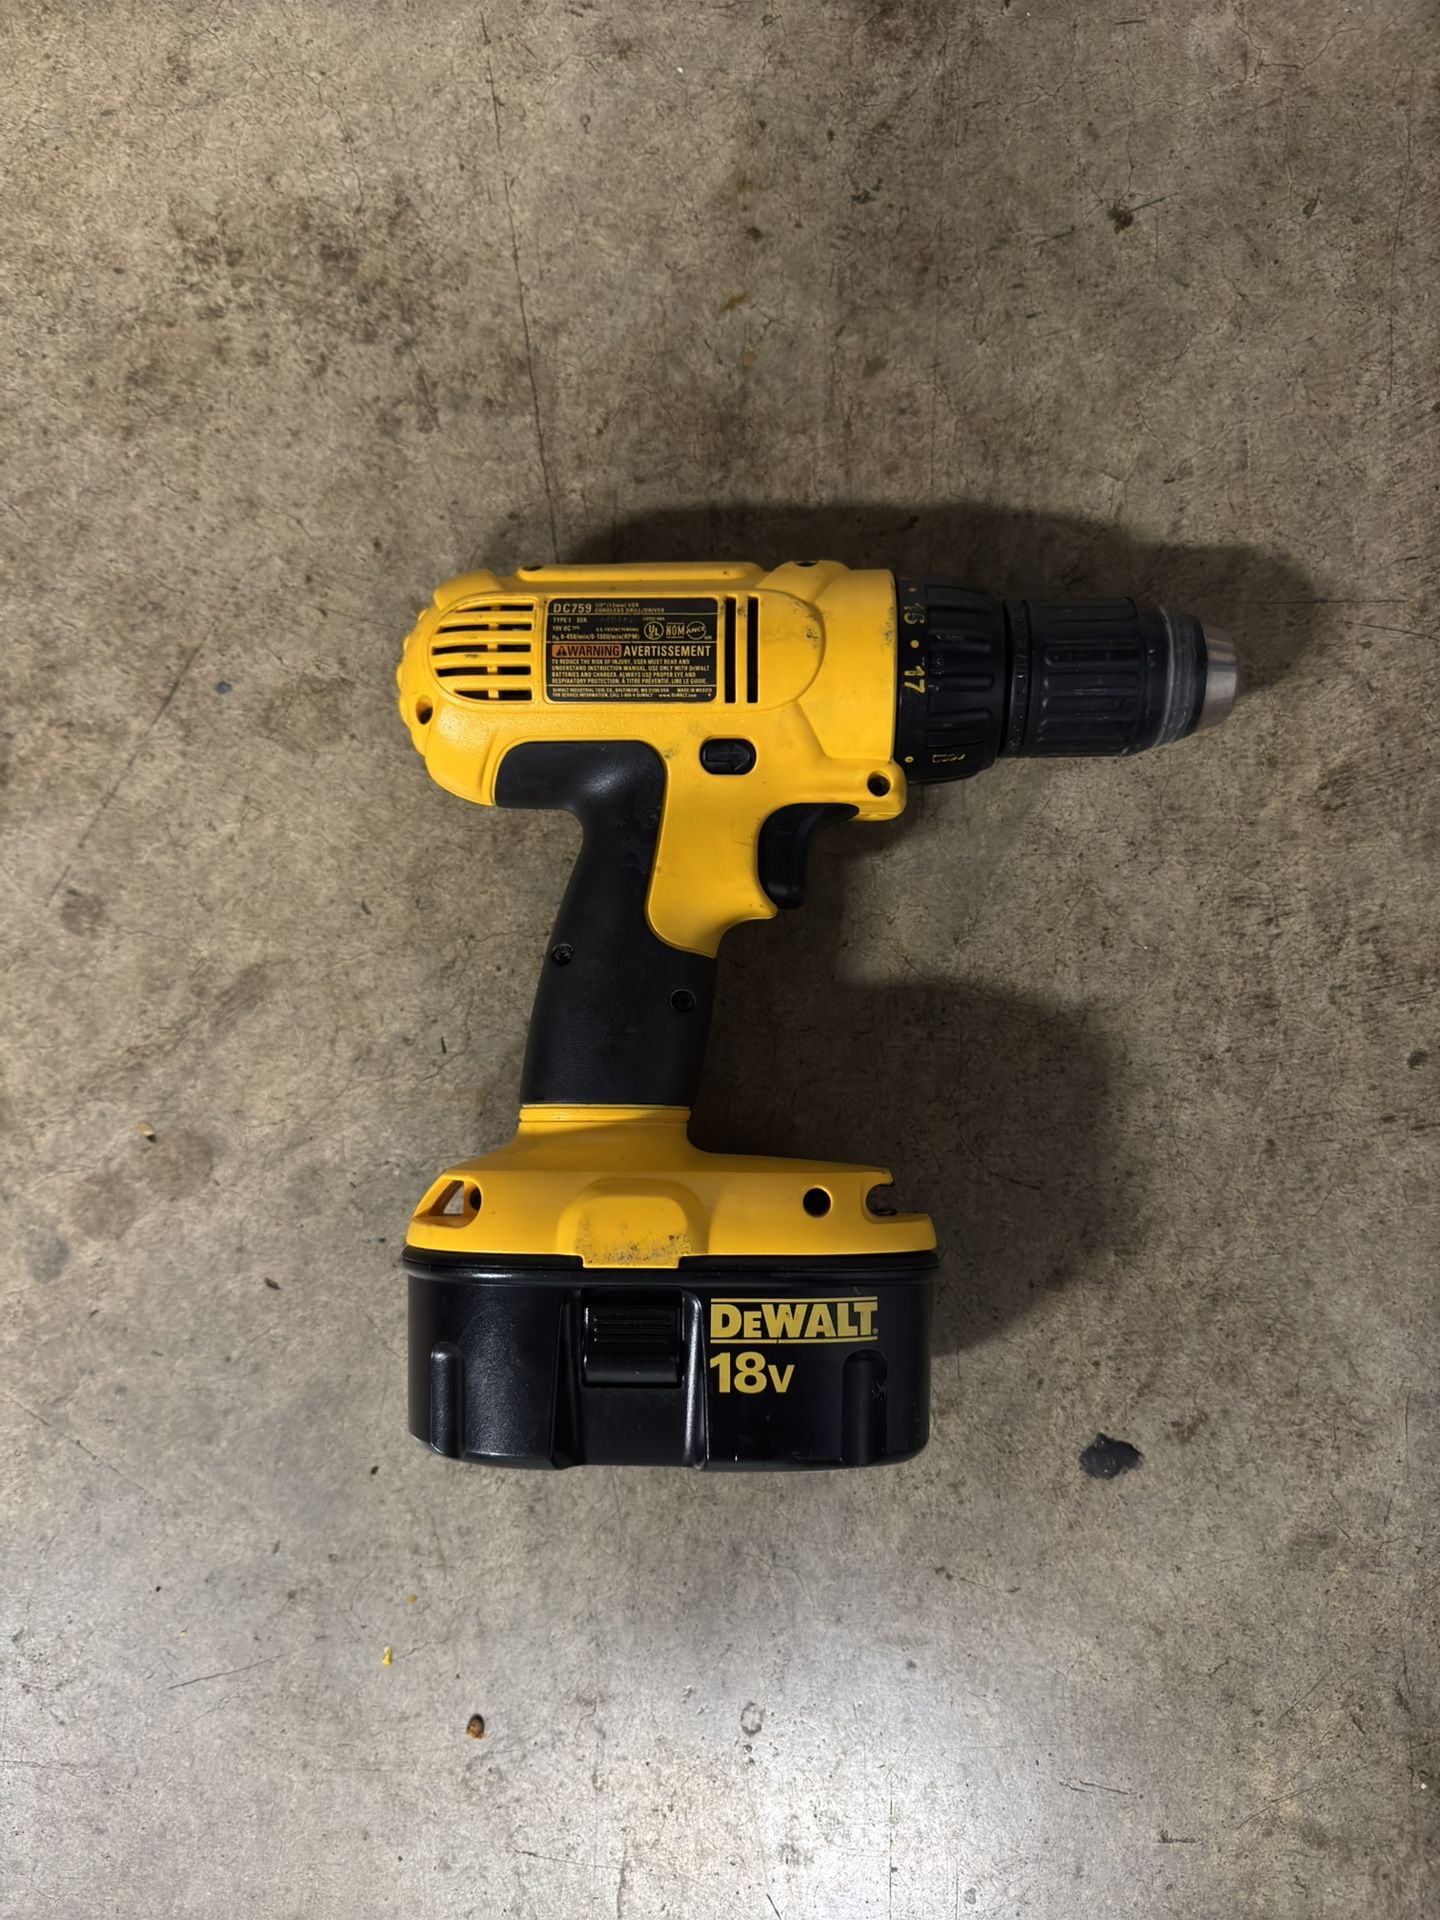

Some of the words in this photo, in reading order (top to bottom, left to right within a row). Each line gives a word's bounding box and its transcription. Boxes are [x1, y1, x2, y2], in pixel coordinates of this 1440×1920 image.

[553, 603, 592, 613] DC759
[666, 625, 685, 636] NOM
[567, 645, 620, 656] WARNING
[623, 645, 711, 656] AVERTISSEMENT
[904, 666, 925, 694] 17
